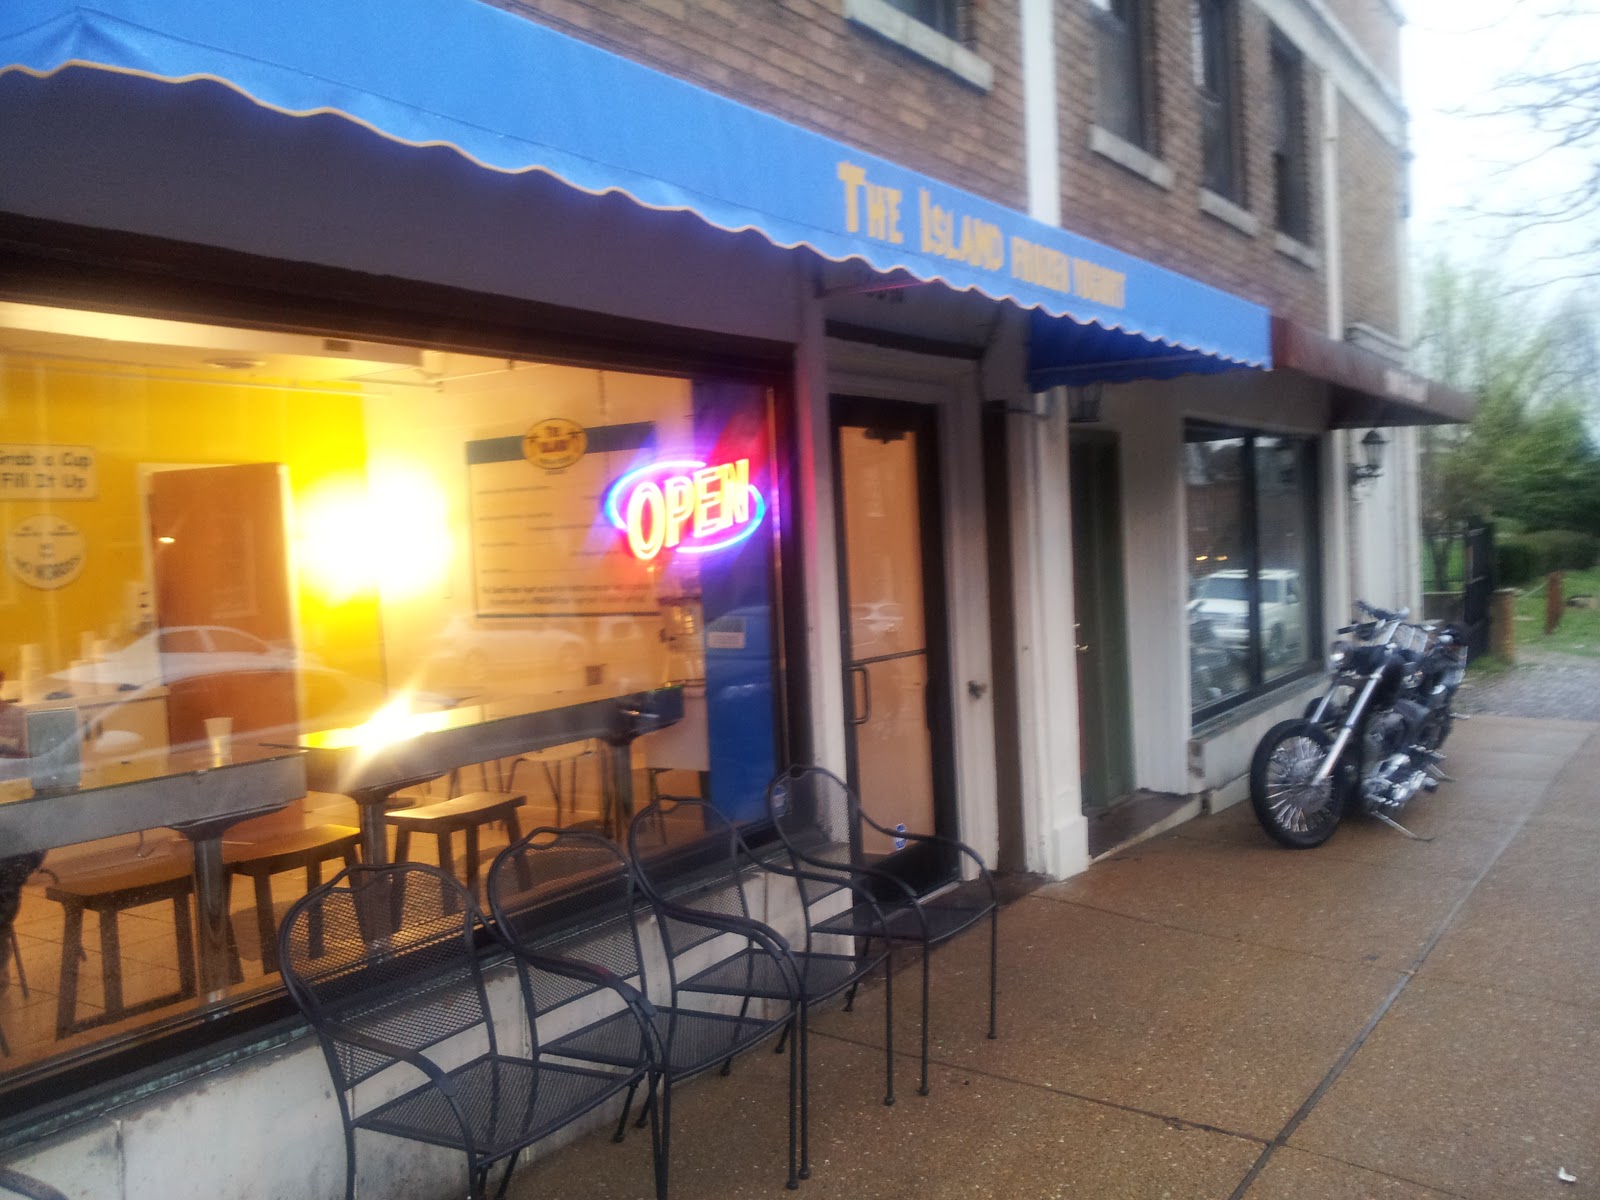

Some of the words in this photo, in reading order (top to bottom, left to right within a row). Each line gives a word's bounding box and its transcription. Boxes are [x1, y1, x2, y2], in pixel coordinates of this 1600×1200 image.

[837, 160, 904, 244] THE
[919, 186, 1004, 271] ISLAND
[627, 457, 750, 560] OPEN
